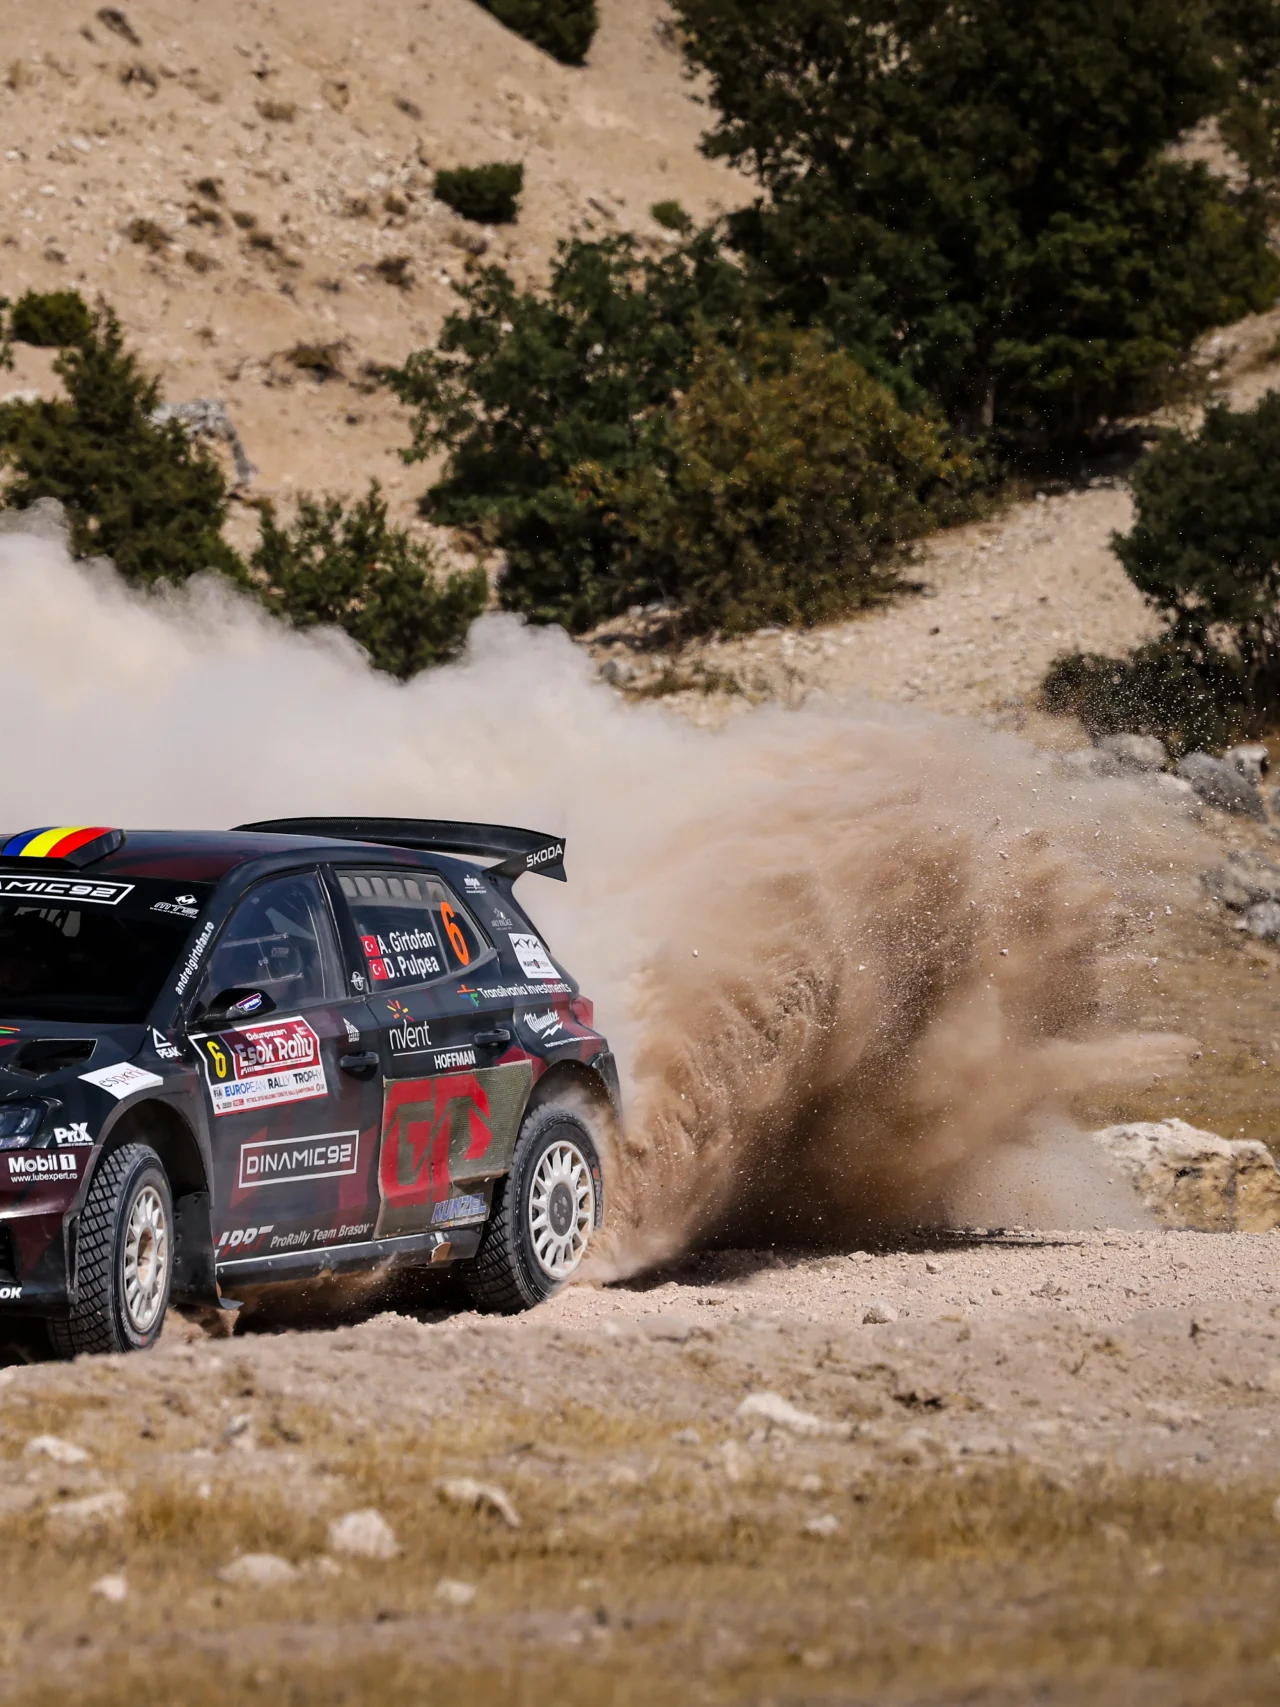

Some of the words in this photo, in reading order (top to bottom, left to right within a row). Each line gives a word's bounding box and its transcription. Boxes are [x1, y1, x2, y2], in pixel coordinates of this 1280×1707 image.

[526, 843, 563, 868] SKODA
[377, 935, 391, 954] A.
[441, 901, 470, 966] 6
[175, 921, 215, 996] andreigirtofan.ro
[383, 957, 400, 979] D.
[397, 954, 440, 979] Pulpea
[477, 982, 527, 999] Transilvania
[527, 982, 572, 995] Investments
[156, 1046, 183, 1059] PEAK
[273, 1030, 314, 1062] Rally
[206, 1041, 227, 1078] 6
[433, 1050, 476, 1070] HOFFMAN
[224, 1080, 267, 1098] EUROPEAN
[268, 1073, 291, 1090] RALLY
[293, 1069, 322, 1084] TROPHY
[8, 1154, 58, 1173] Mobil
[59, 1154, 77, 1170] 1
[246, 1143, 352, 1175] DINAMIC92
[11, 1172, 78, 1183] www.lubexpert.ro
[270, 1230, 310, 1248] ProRally
[312, 1228, 337, 1241] Team
[338, 1223, 370, 1237] Brasov
